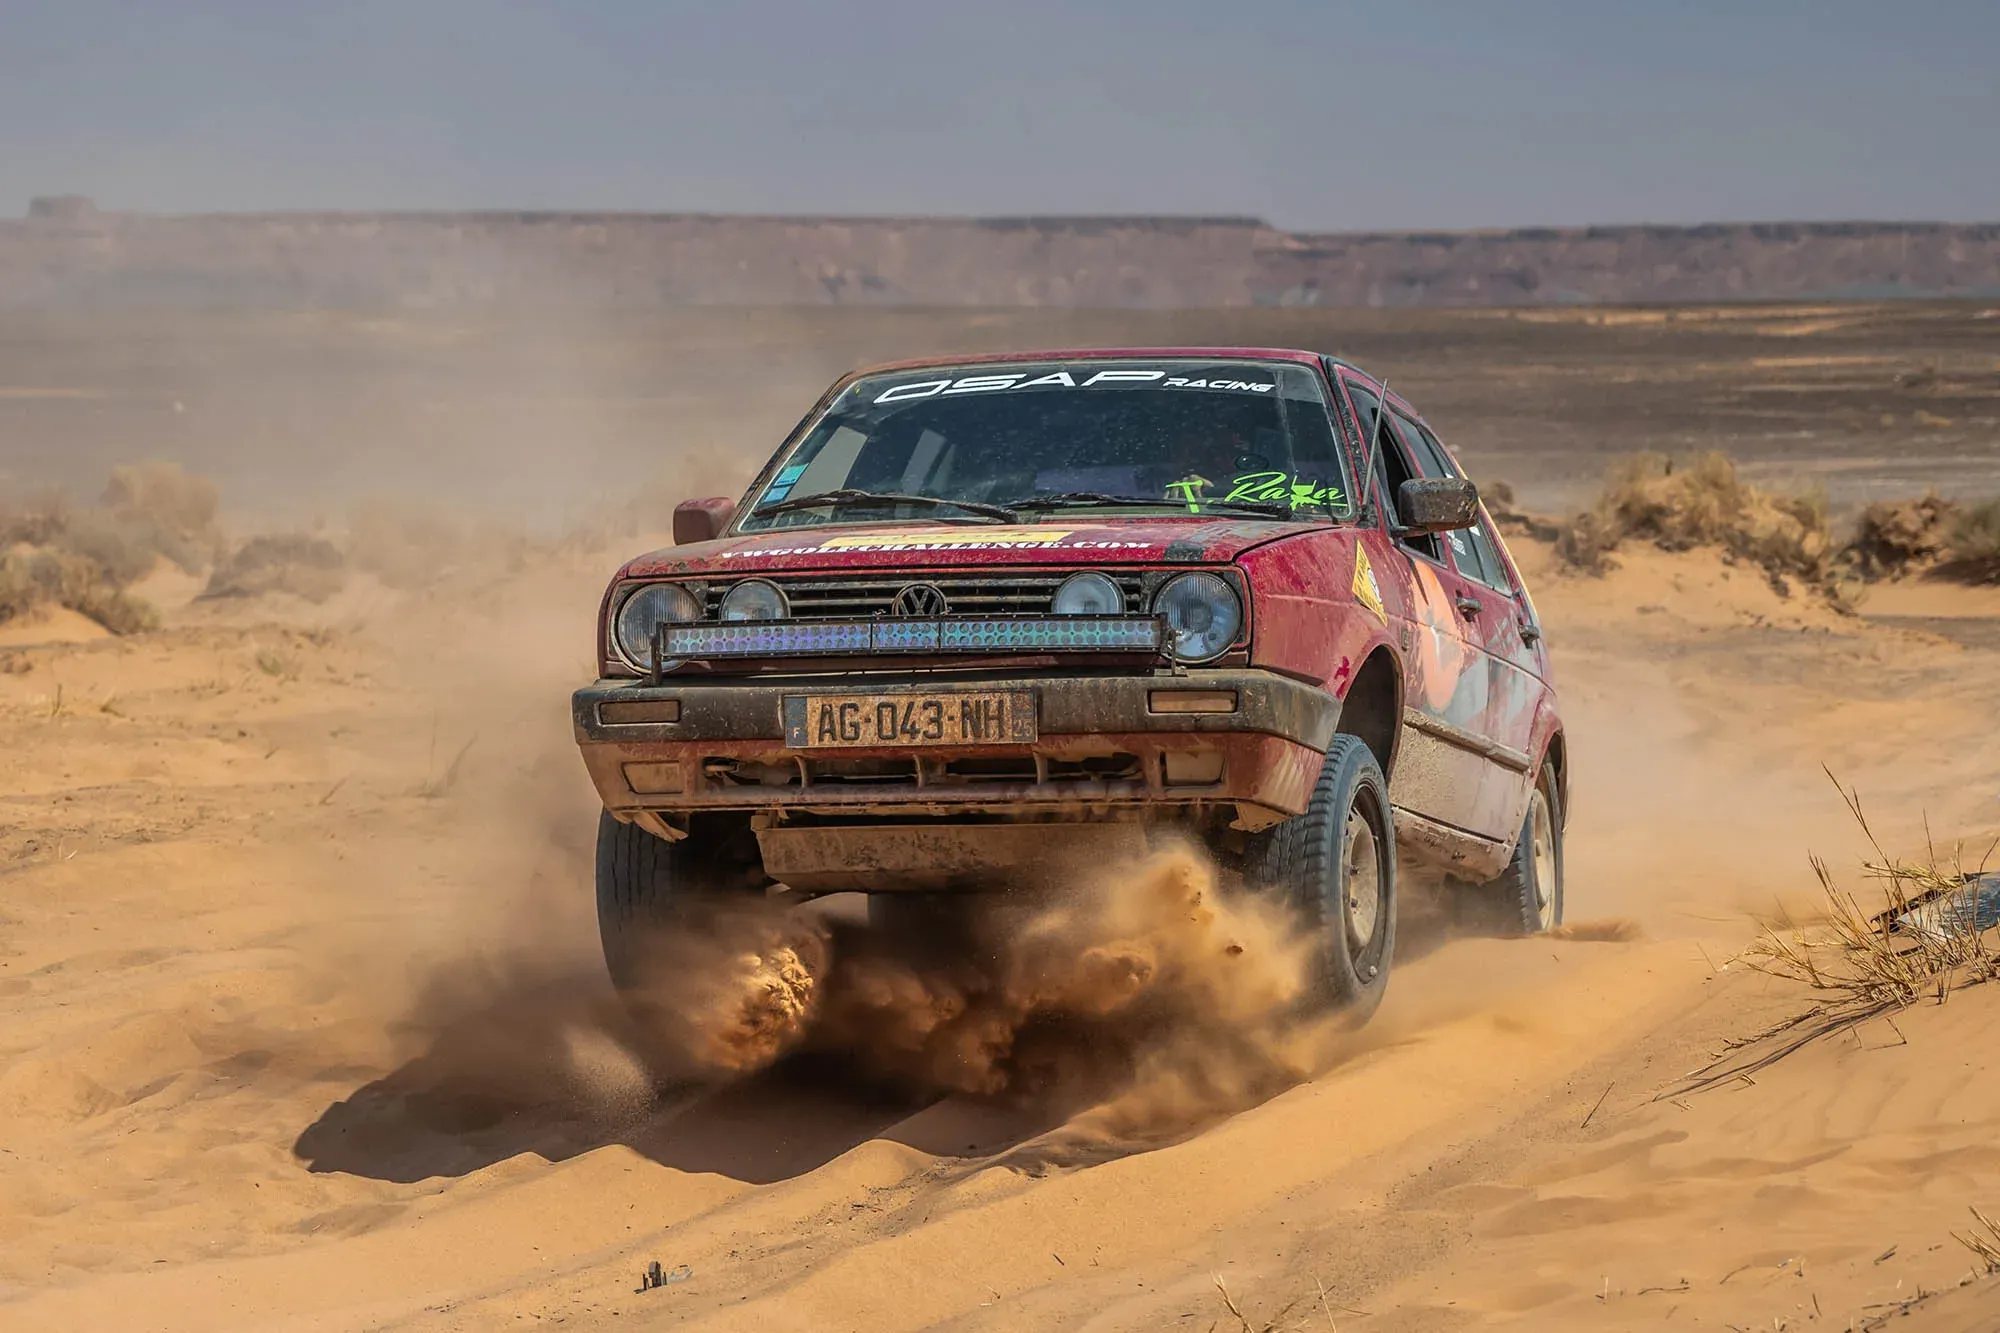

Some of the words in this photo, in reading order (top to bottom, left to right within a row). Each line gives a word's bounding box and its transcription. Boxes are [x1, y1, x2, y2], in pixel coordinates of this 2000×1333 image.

[873, 370, 1165, 404] OSAP
[1163, 377, 1276, 393] RACING
[793, 727, 801, 739] F
[817, 699, 1005, 742] AG-043-NH
